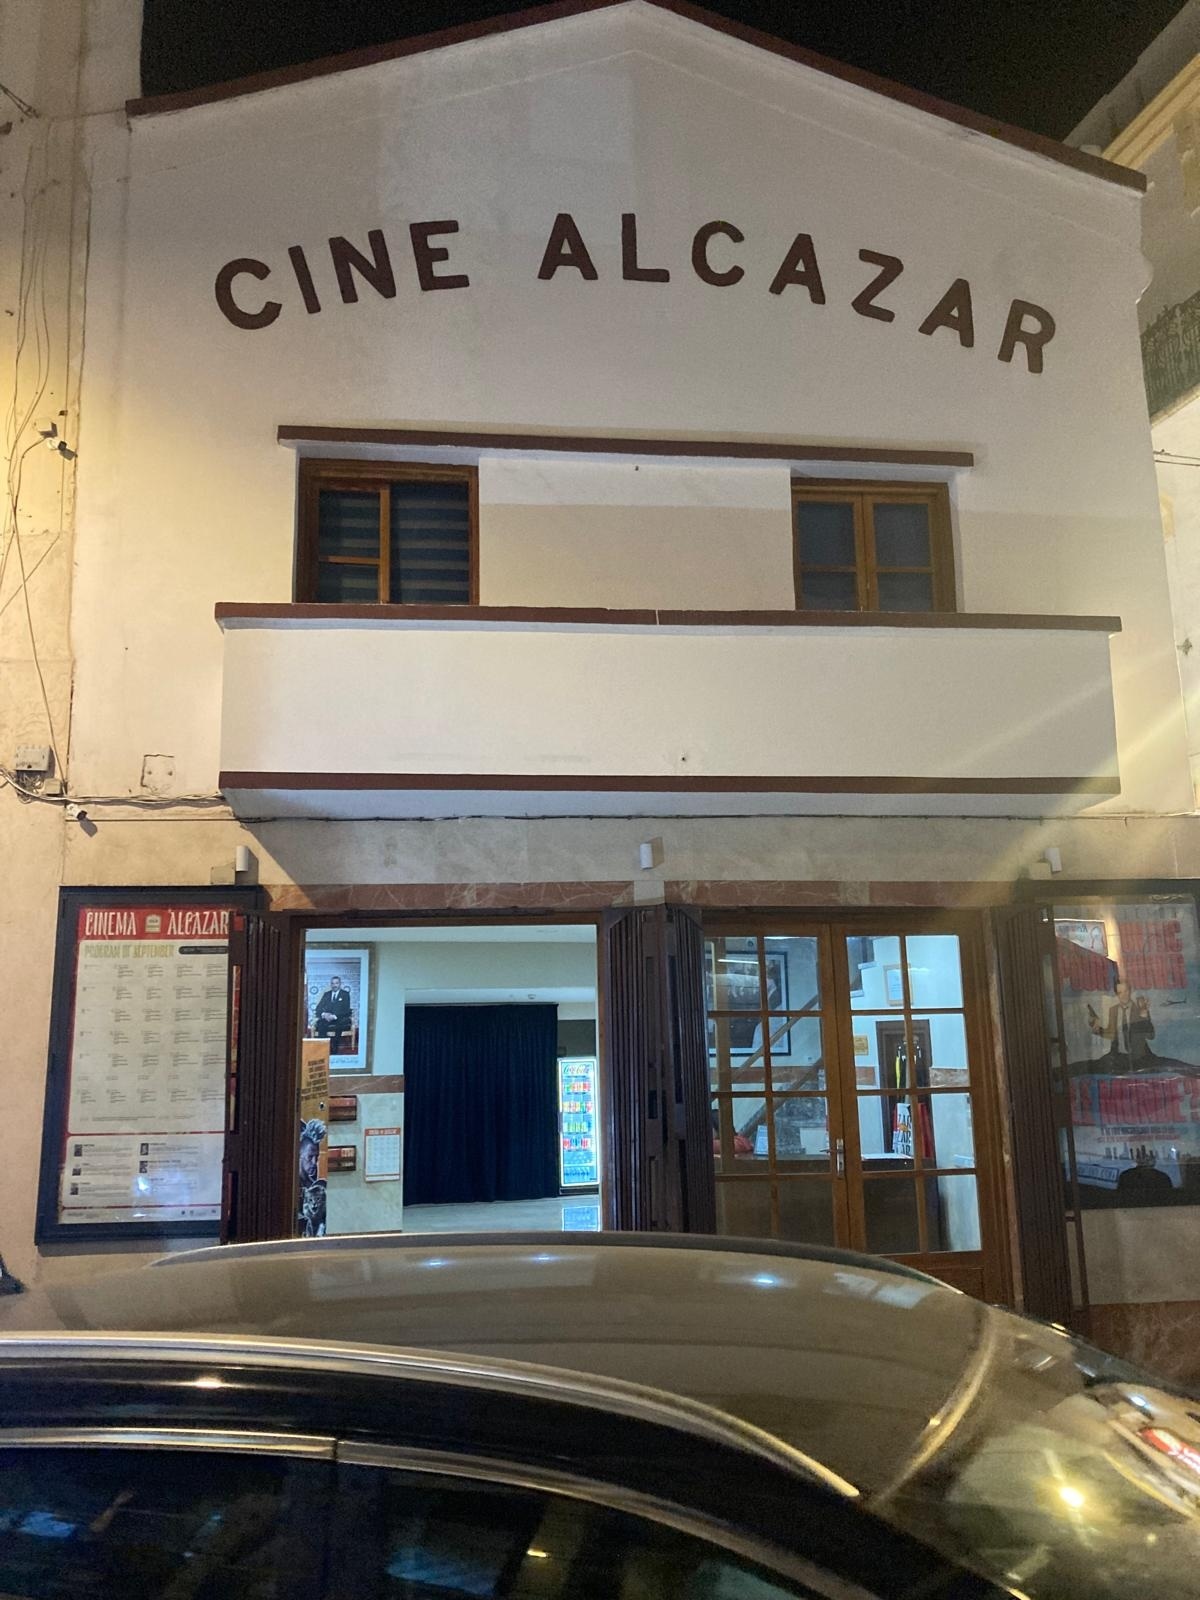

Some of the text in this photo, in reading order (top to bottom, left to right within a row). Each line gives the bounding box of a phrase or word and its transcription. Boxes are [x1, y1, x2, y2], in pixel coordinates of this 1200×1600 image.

[214, 212, 1056, 374] CINE ALCAZAR
[85, 911, 137, 936] CINEMA
[167, 910, 229, 935] ALCAZAR
